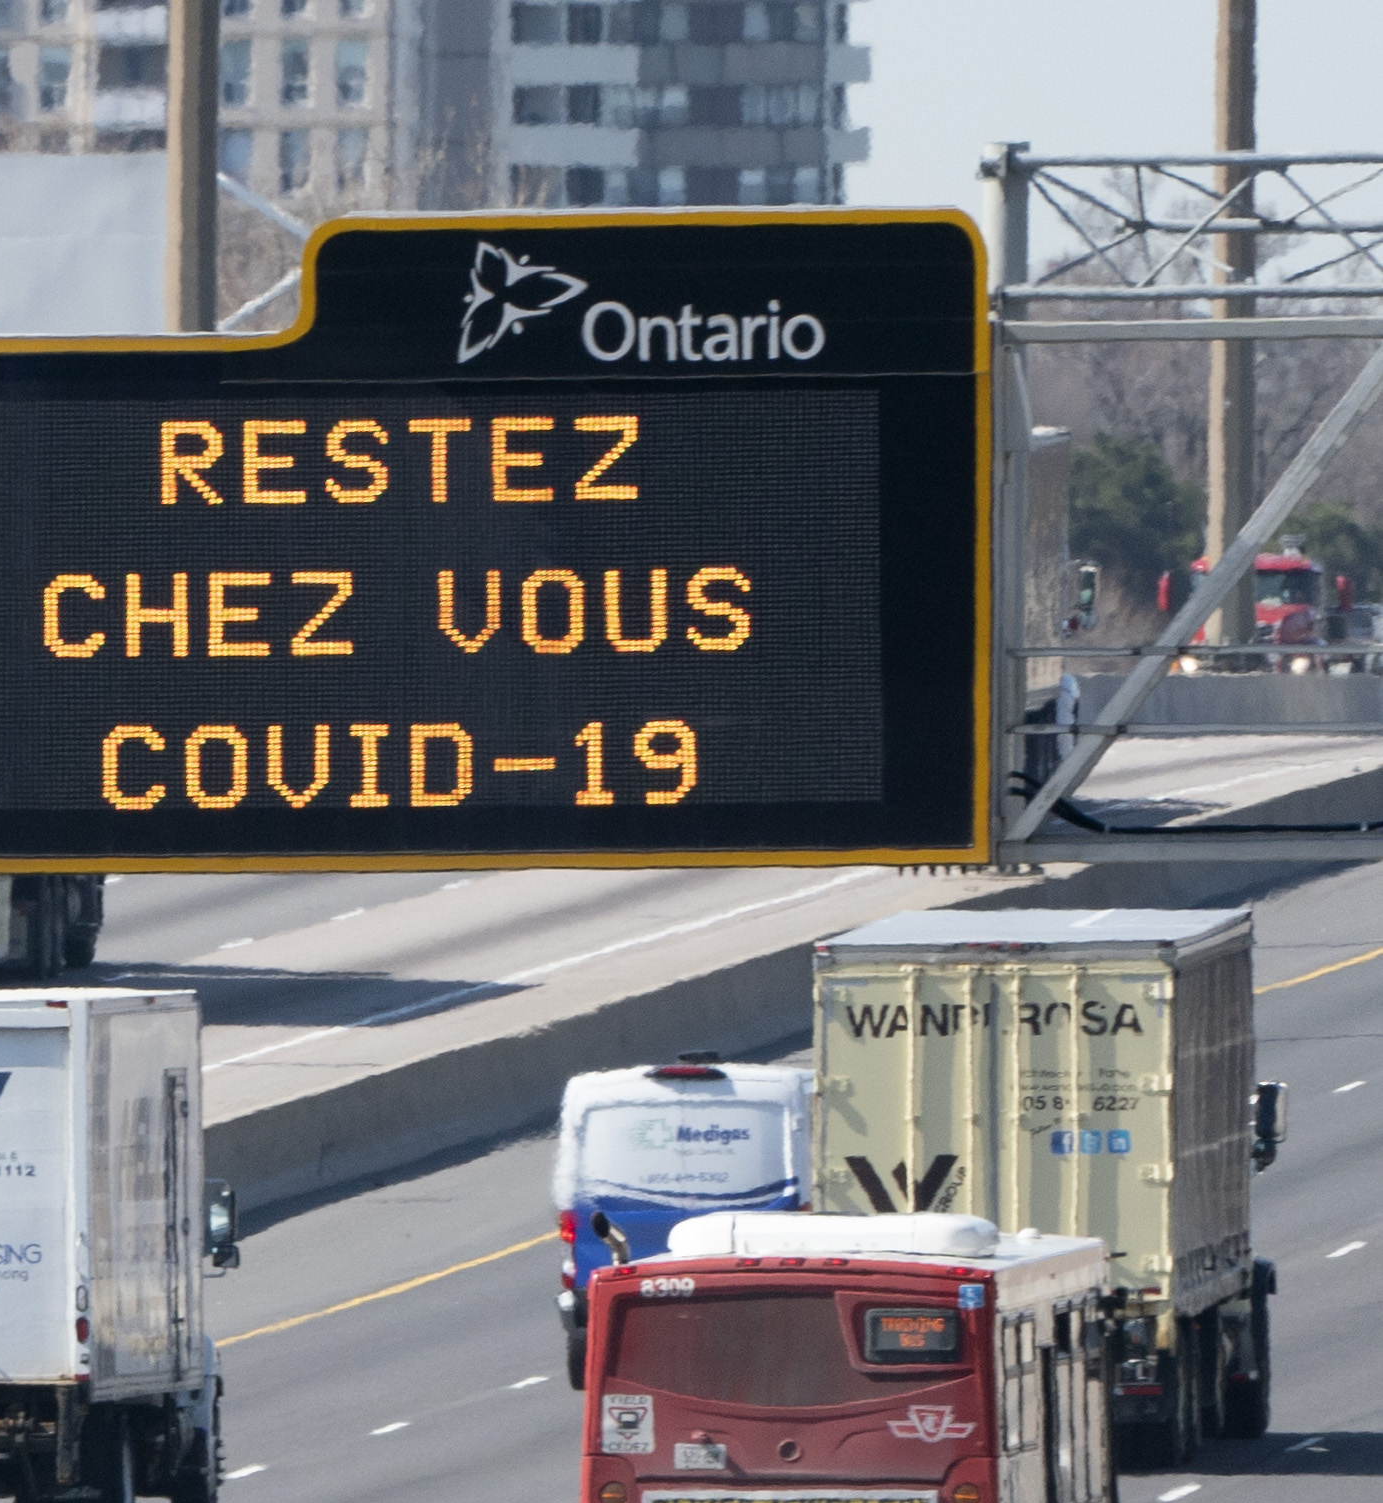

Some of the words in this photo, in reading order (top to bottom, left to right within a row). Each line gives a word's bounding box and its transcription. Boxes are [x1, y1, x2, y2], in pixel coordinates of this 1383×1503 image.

[582, 300, 826, 362] Ontario
[161, 416, 639, 505] RESTEZ
[44, 572, 353, 658] CHEZ
[438, 567, 751, 654] VOUS
[103, 721, 697, 810] COVID-19
[1093, 1095, 1141, 1111] 6227
